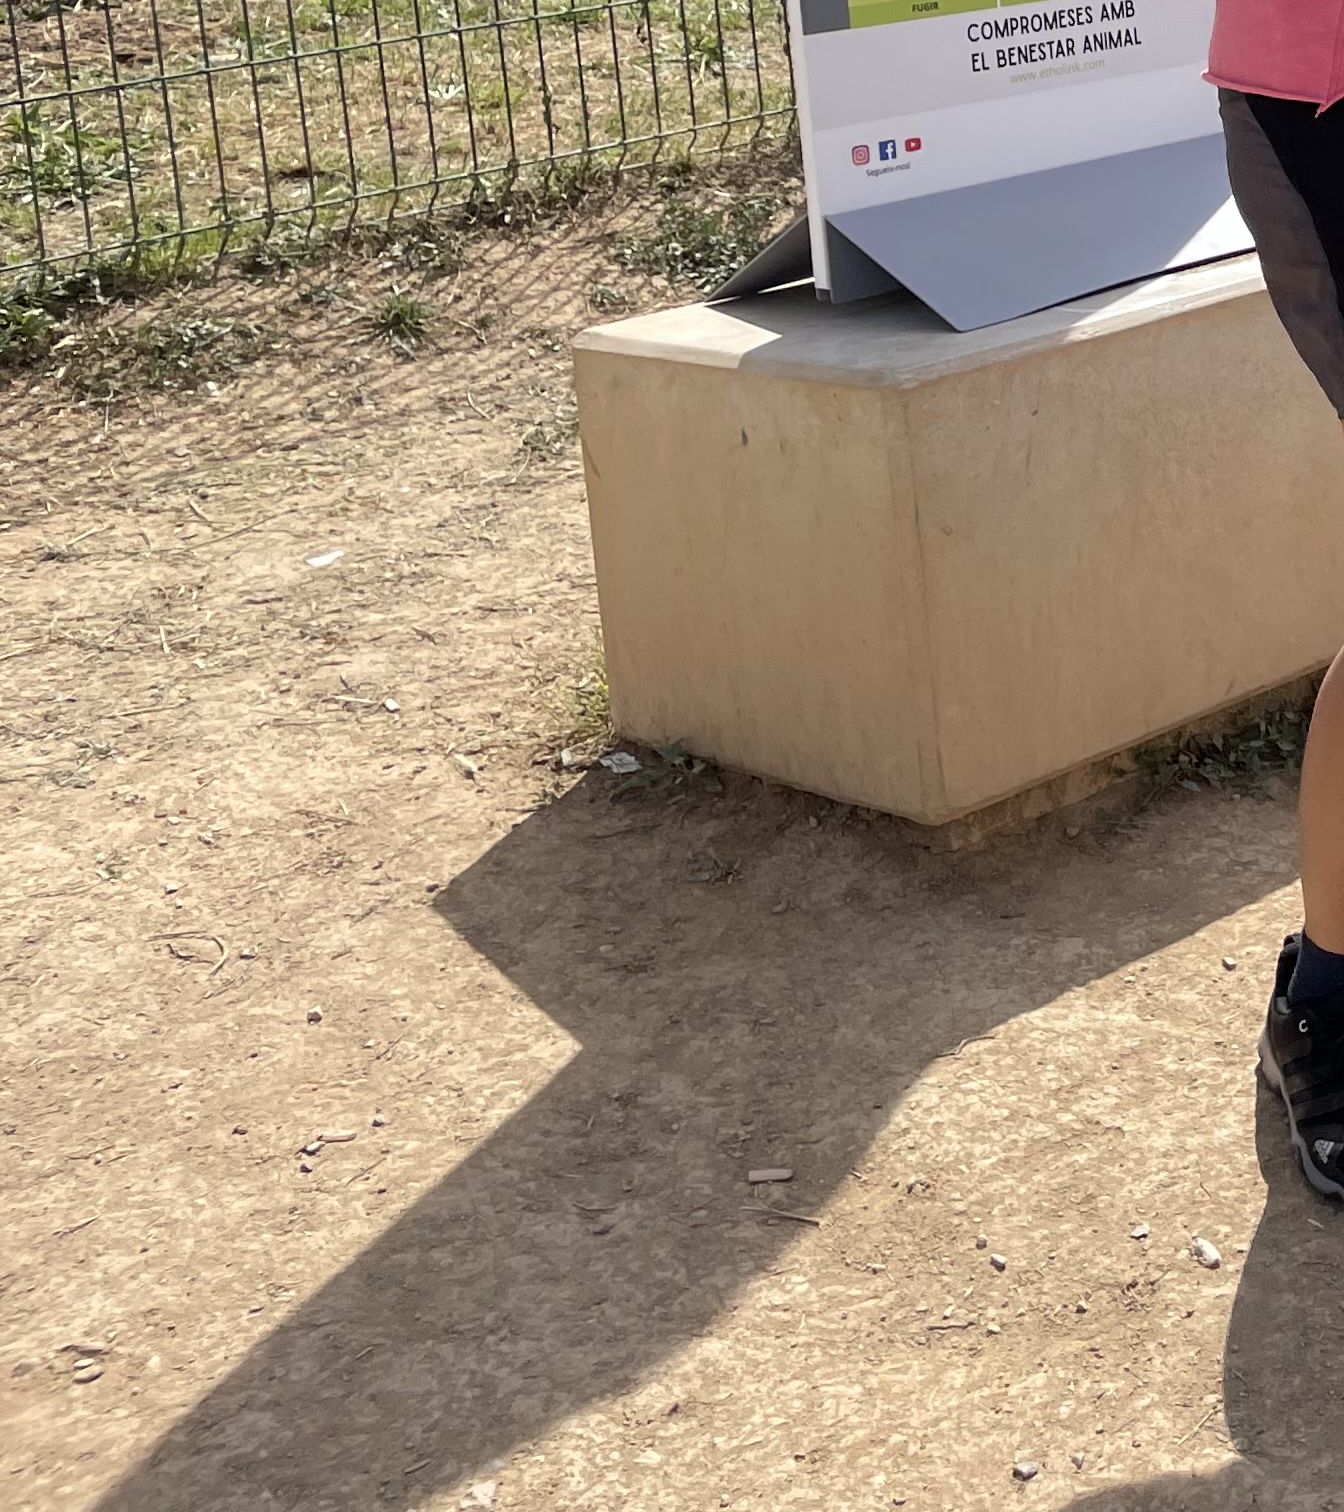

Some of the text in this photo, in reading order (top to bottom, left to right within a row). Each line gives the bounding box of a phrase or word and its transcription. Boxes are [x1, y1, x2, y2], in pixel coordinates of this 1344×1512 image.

[967, 0, 1136, 42] COMPROMESES AMB
[971, 27, 1143, 72] EL BENESTAR ANIMAL
[1009, 58, 1106, 85] www.etholink.com
